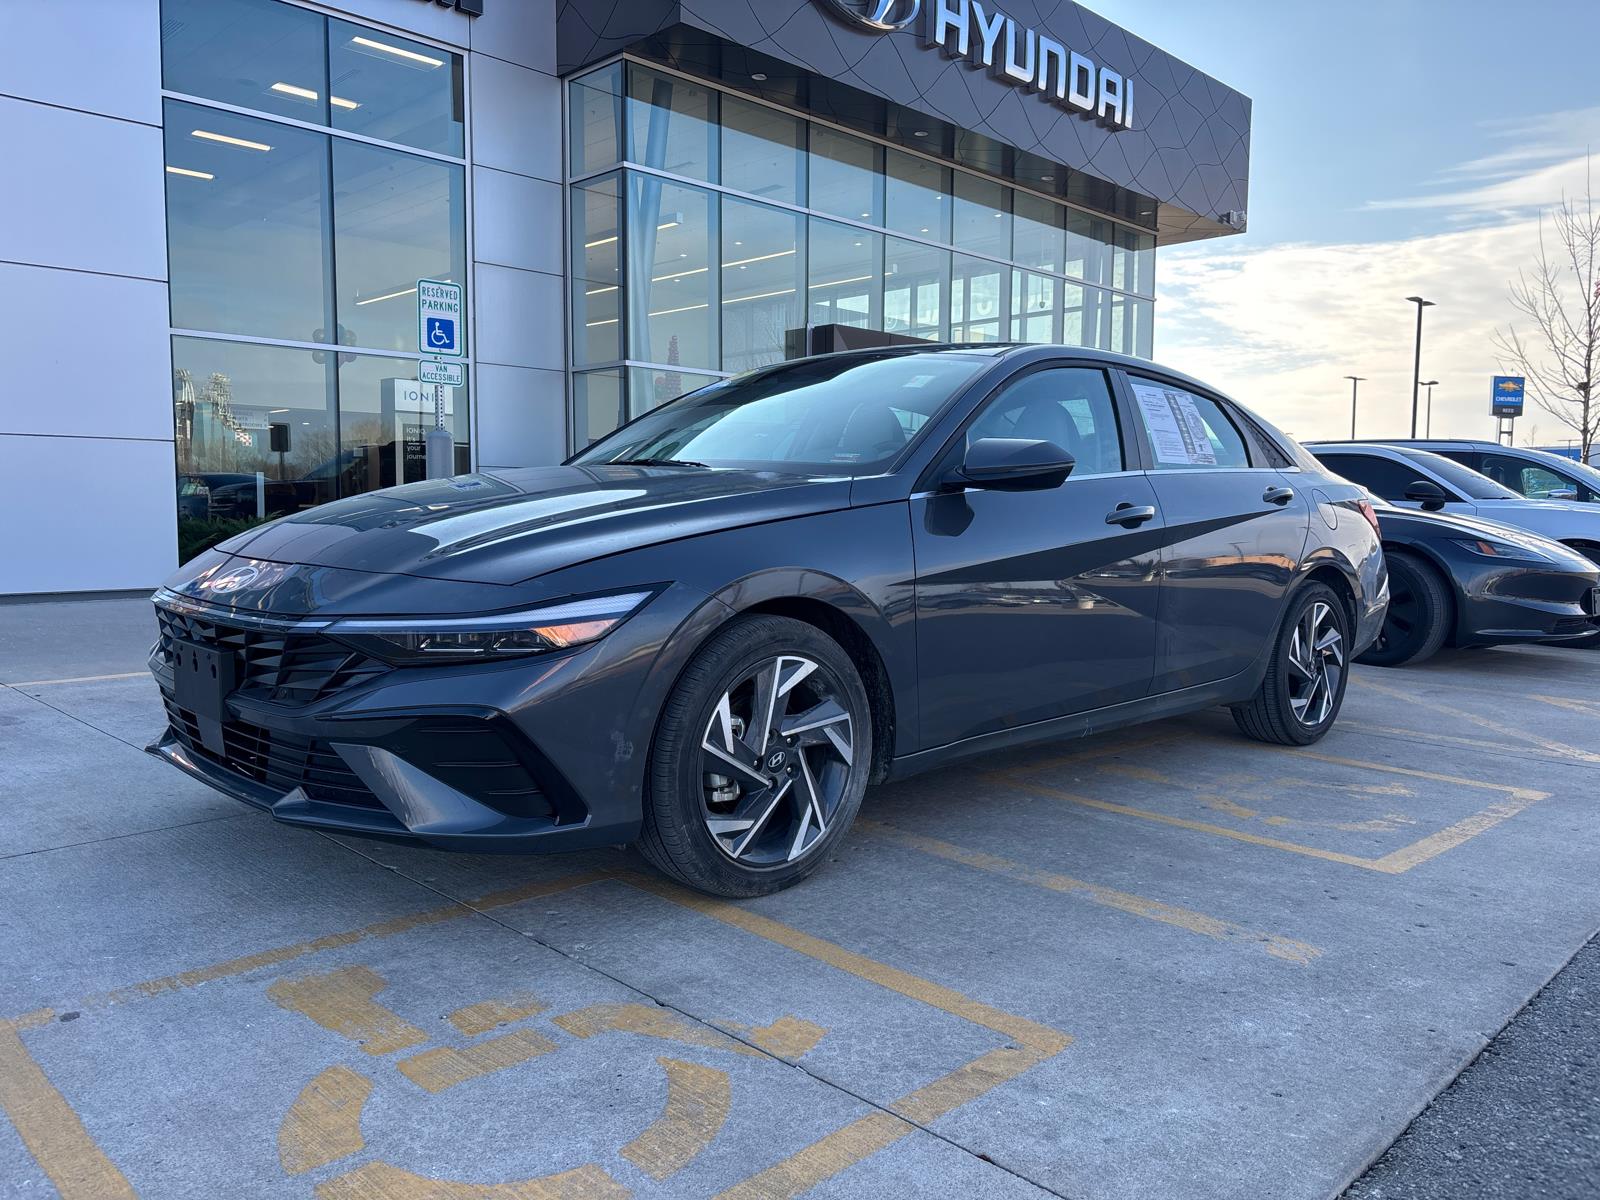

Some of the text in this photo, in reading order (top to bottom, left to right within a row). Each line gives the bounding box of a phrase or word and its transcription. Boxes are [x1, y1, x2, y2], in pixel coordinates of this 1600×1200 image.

[932, 0, 1134, 129] HYUNDAI
[421, 286, 458, 300] RESERVED
[421, 299, 459, 313] PARKING
[435, 364, 448, 373] VAN
[421, 372, 461, 383] ACCESSIBLE
[404, 390, 435, 402] IONI
